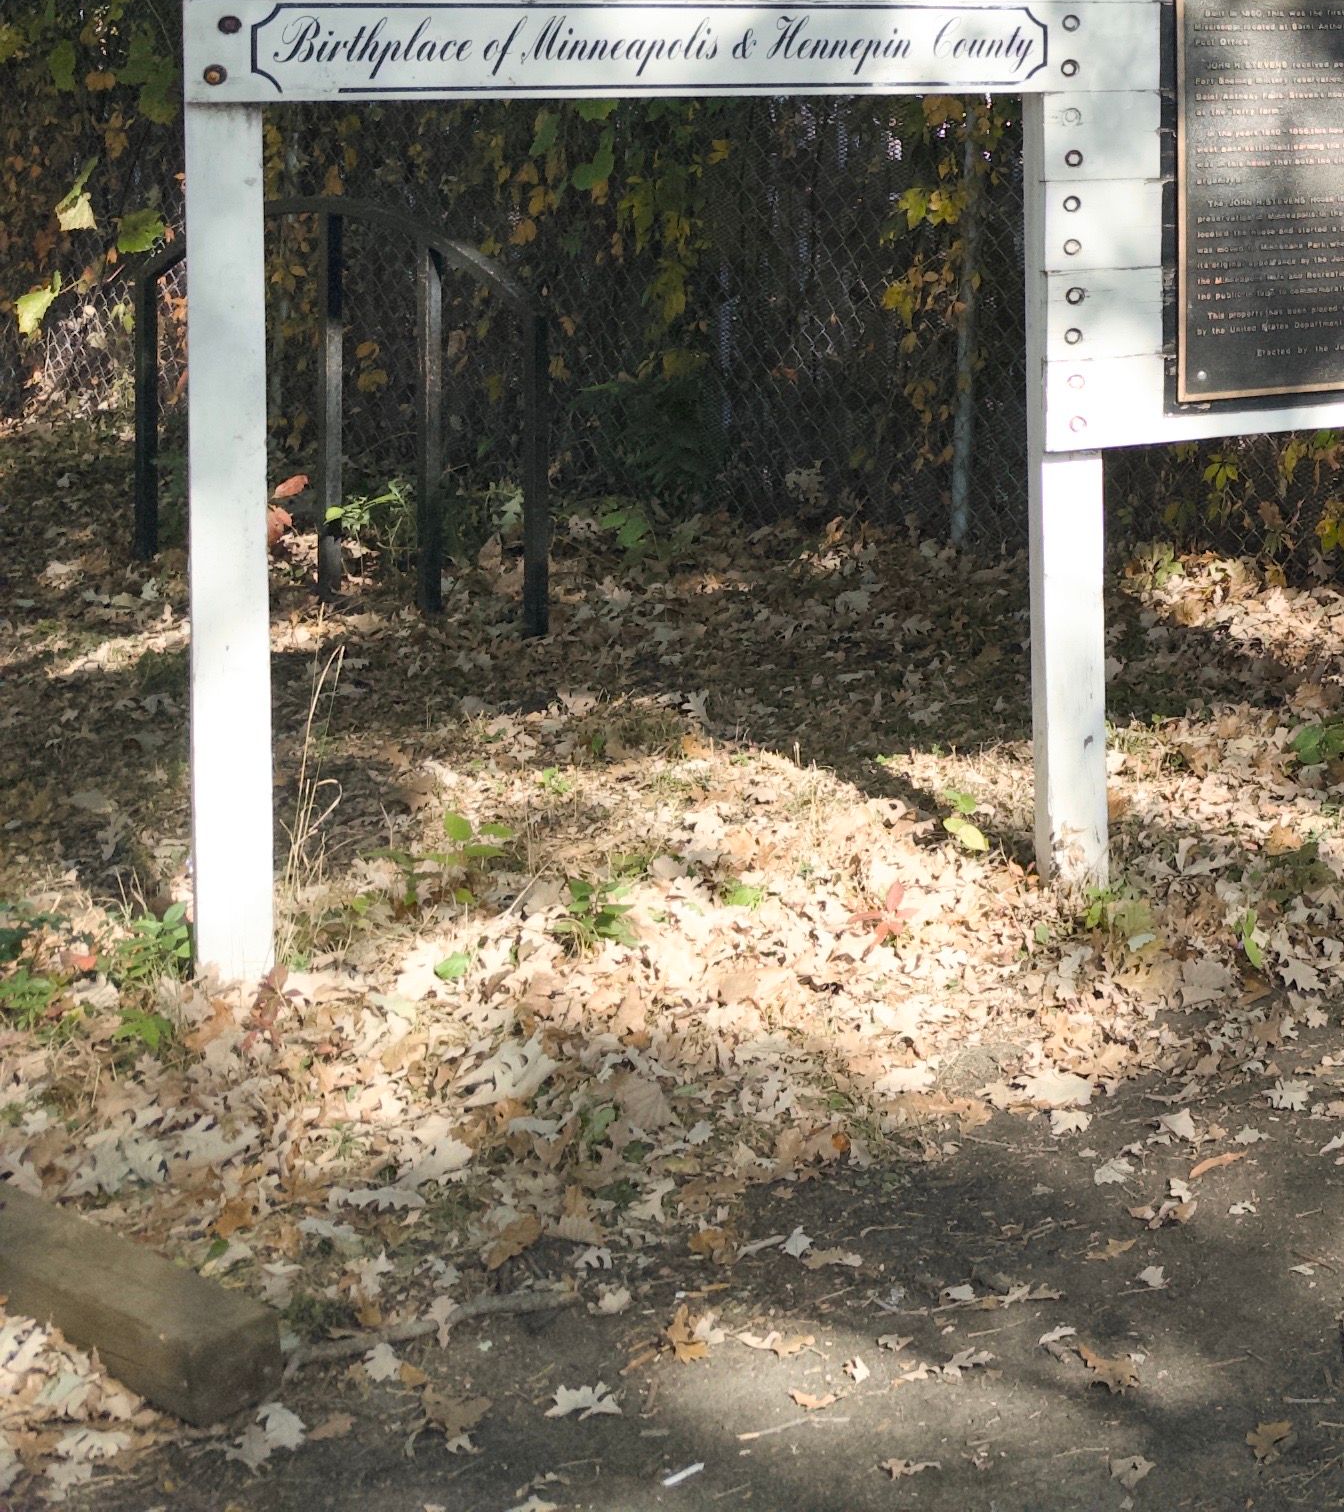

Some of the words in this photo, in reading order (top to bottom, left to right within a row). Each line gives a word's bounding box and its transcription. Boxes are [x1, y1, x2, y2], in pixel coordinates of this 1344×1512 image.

[1327, 8, 1344, 17] first
[273, 15, 474, 79] Birthplace
[483, 16, 529, 77] of
[520, 15, 718, 77] Minneapolis
[732, 27, 758, 60] &
[766, 14, 912, 76] Hennepin
[932, 14, 1035, 73] County
[1245, 60, 1288, 69] STEVENS
[1194, 76, 1215, 85] Fort
[1207, 310, 1225, 320] This
[1212, 325, 1226, 334] the
[1315, 343, 1328, 352] the
